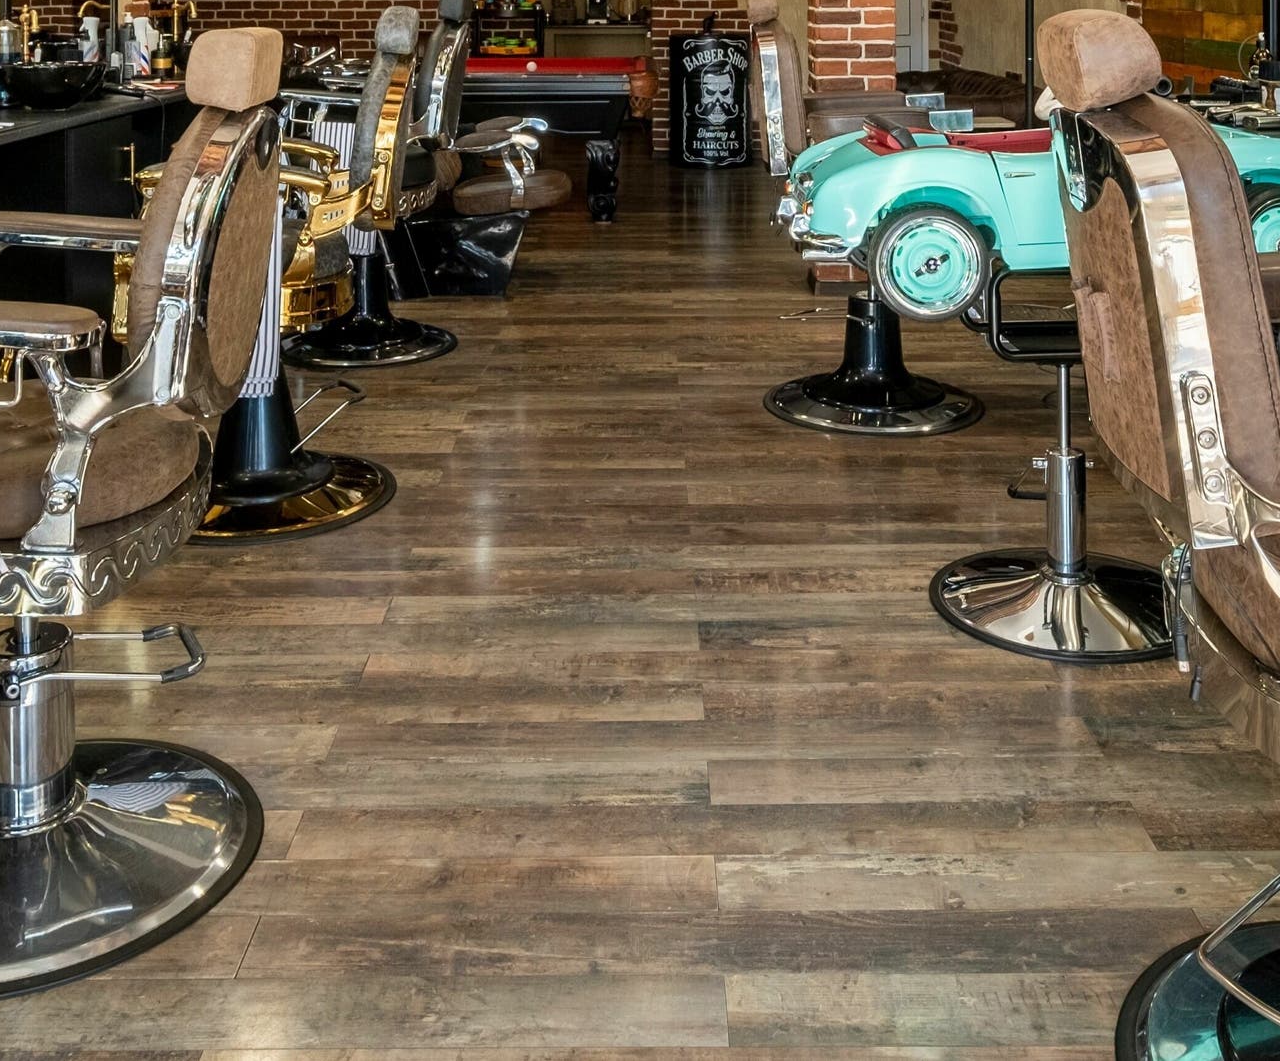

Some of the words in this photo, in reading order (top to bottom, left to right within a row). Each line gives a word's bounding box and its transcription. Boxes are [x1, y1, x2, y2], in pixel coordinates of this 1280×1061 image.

[682, 48, 724, 72] BARBER
[727, 47, 748, 72] SHOP
[696, 127, 728, 141] Shaving
[729, 130, 736, 139] &
[693, 140, 739, 150] HAIRCUTS
